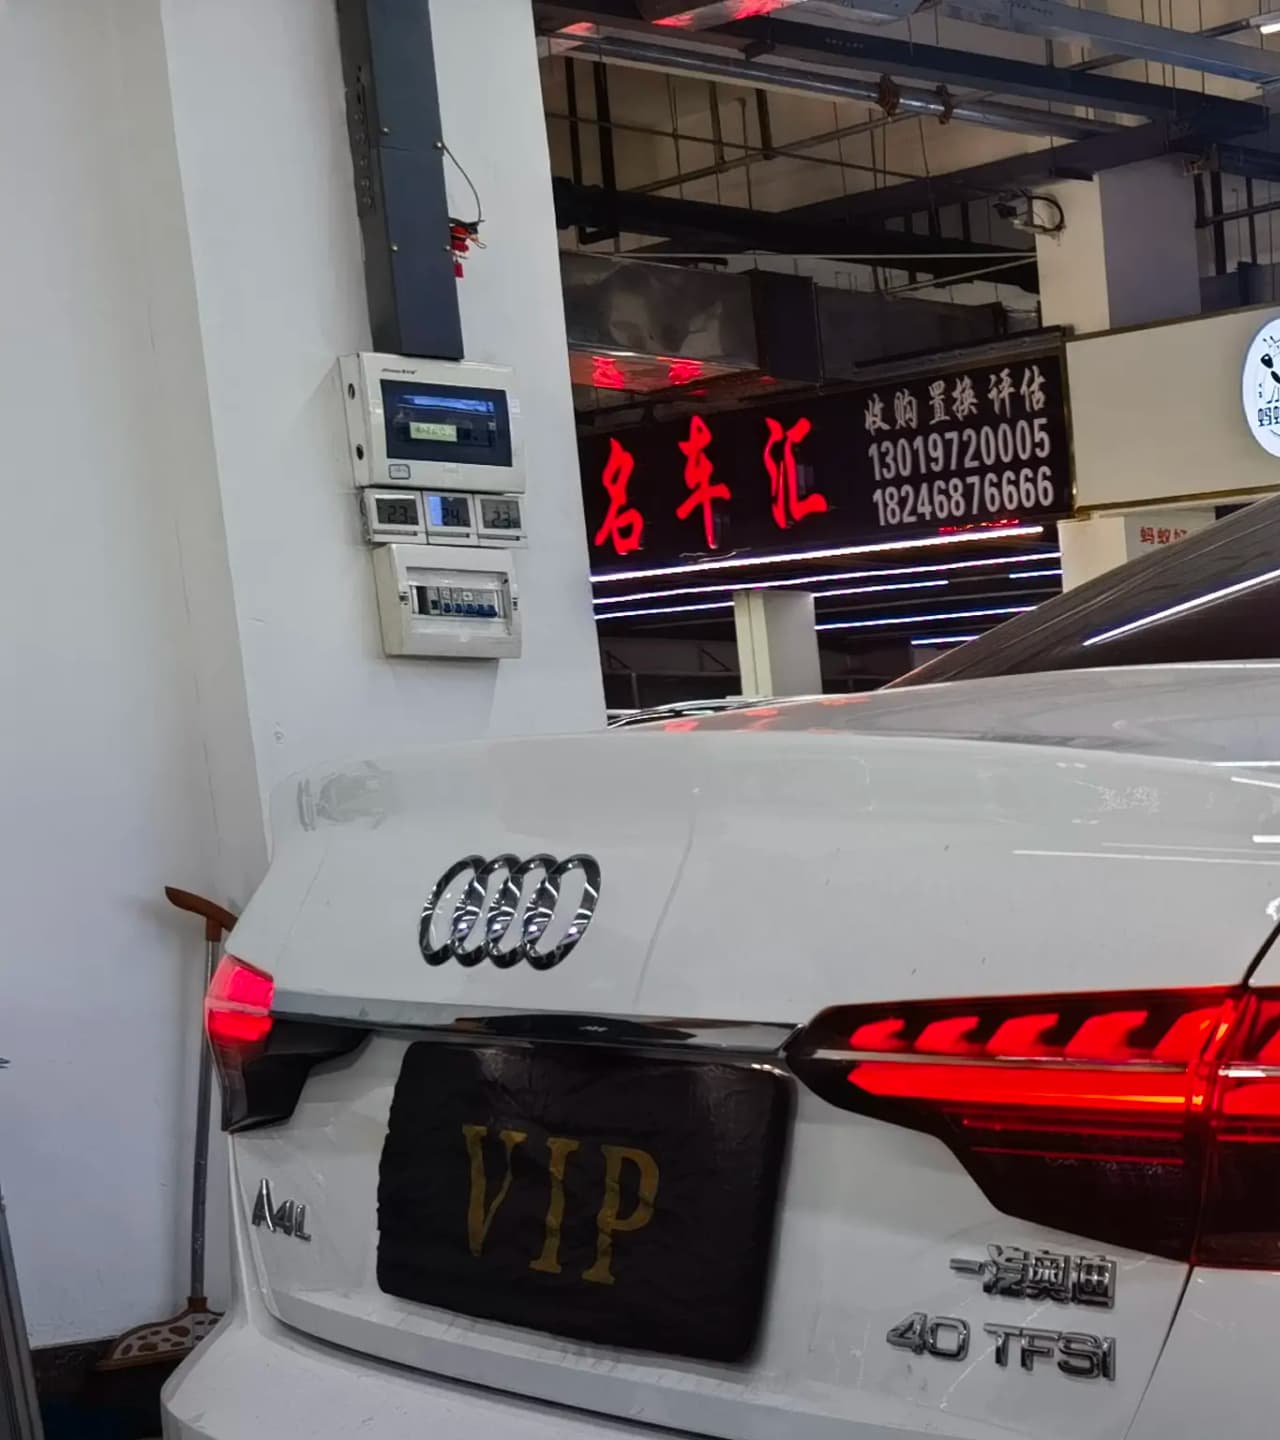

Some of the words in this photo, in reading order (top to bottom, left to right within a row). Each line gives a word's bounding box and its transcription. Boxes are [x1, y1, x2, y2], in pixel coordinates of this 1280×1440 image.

[864, 388, 918, 436] 收购
[928, 374, 979, 425] 置换
[988, 364, 1047, 418] 评估
[868, 417, 1051, 481] 13019720005
[594, 414, 828, 556] 名车汇
[872, 465, 1054, 526] 18246876666
[251, 1178, 312, 1241] A4L
[462, 1123, 660, 1285] VIP
[886, 1312, 970, 1362] 40
[984, 1322, 1117, 1381] TFSI
